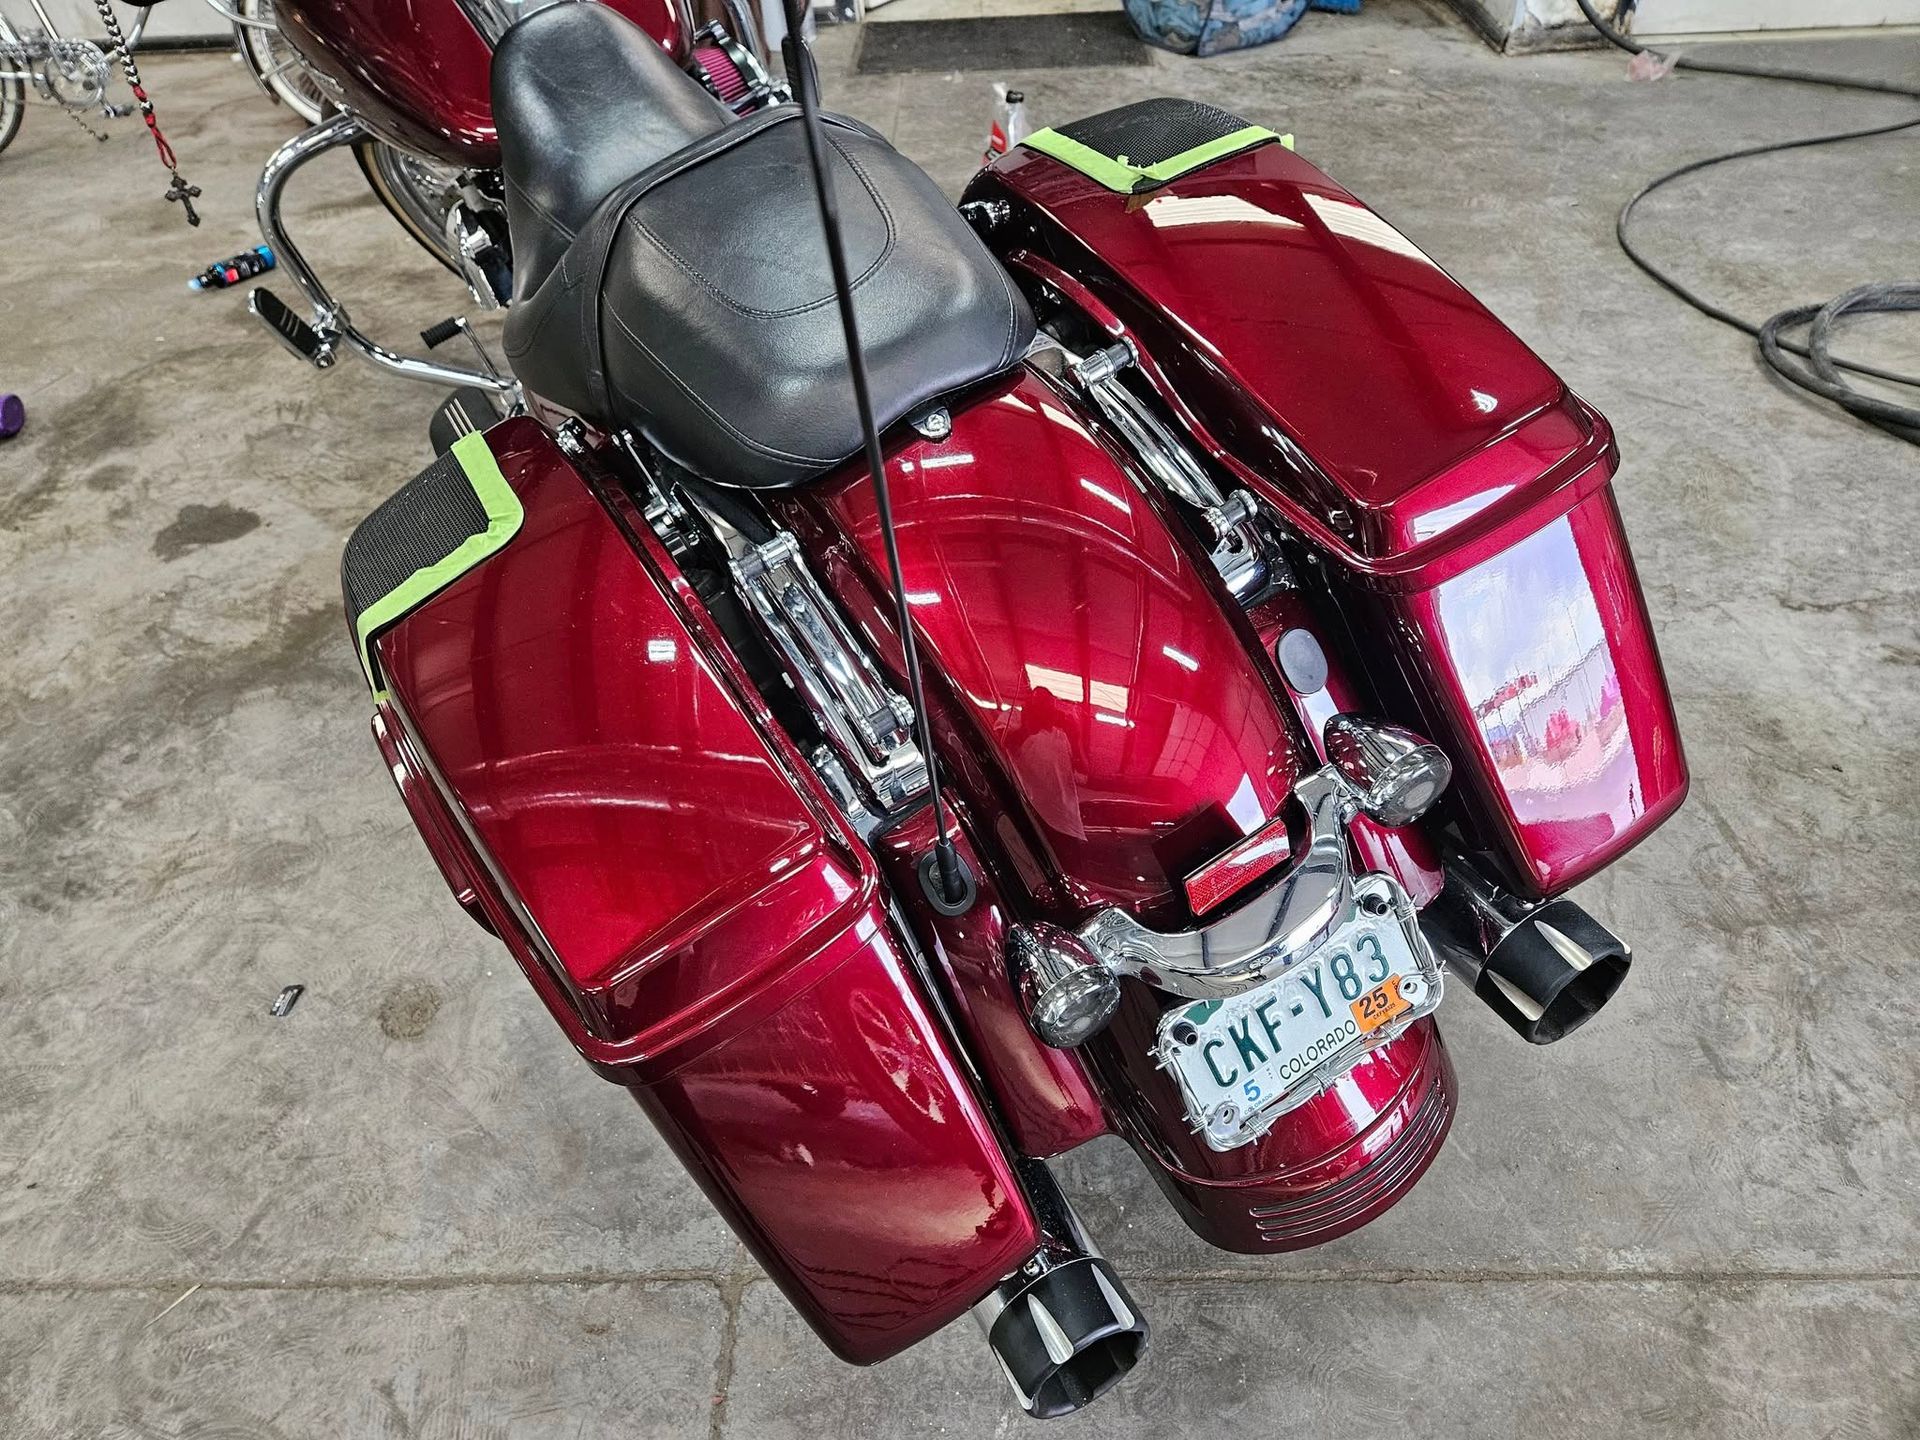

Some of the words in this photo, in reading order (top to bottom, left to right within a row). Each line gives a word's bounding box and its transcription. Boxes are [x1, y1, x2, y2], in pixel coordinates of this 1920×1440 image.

[1203, 933, 1390, 1088] CKF-Y83
[1359, 986, 1389, 1019] 25
[1280, 1020, 1356, 1080] COLORADO
[1243, 1078, 1261, 1102] 5
[1244, 1092, 1273, 1115] COLORADO
